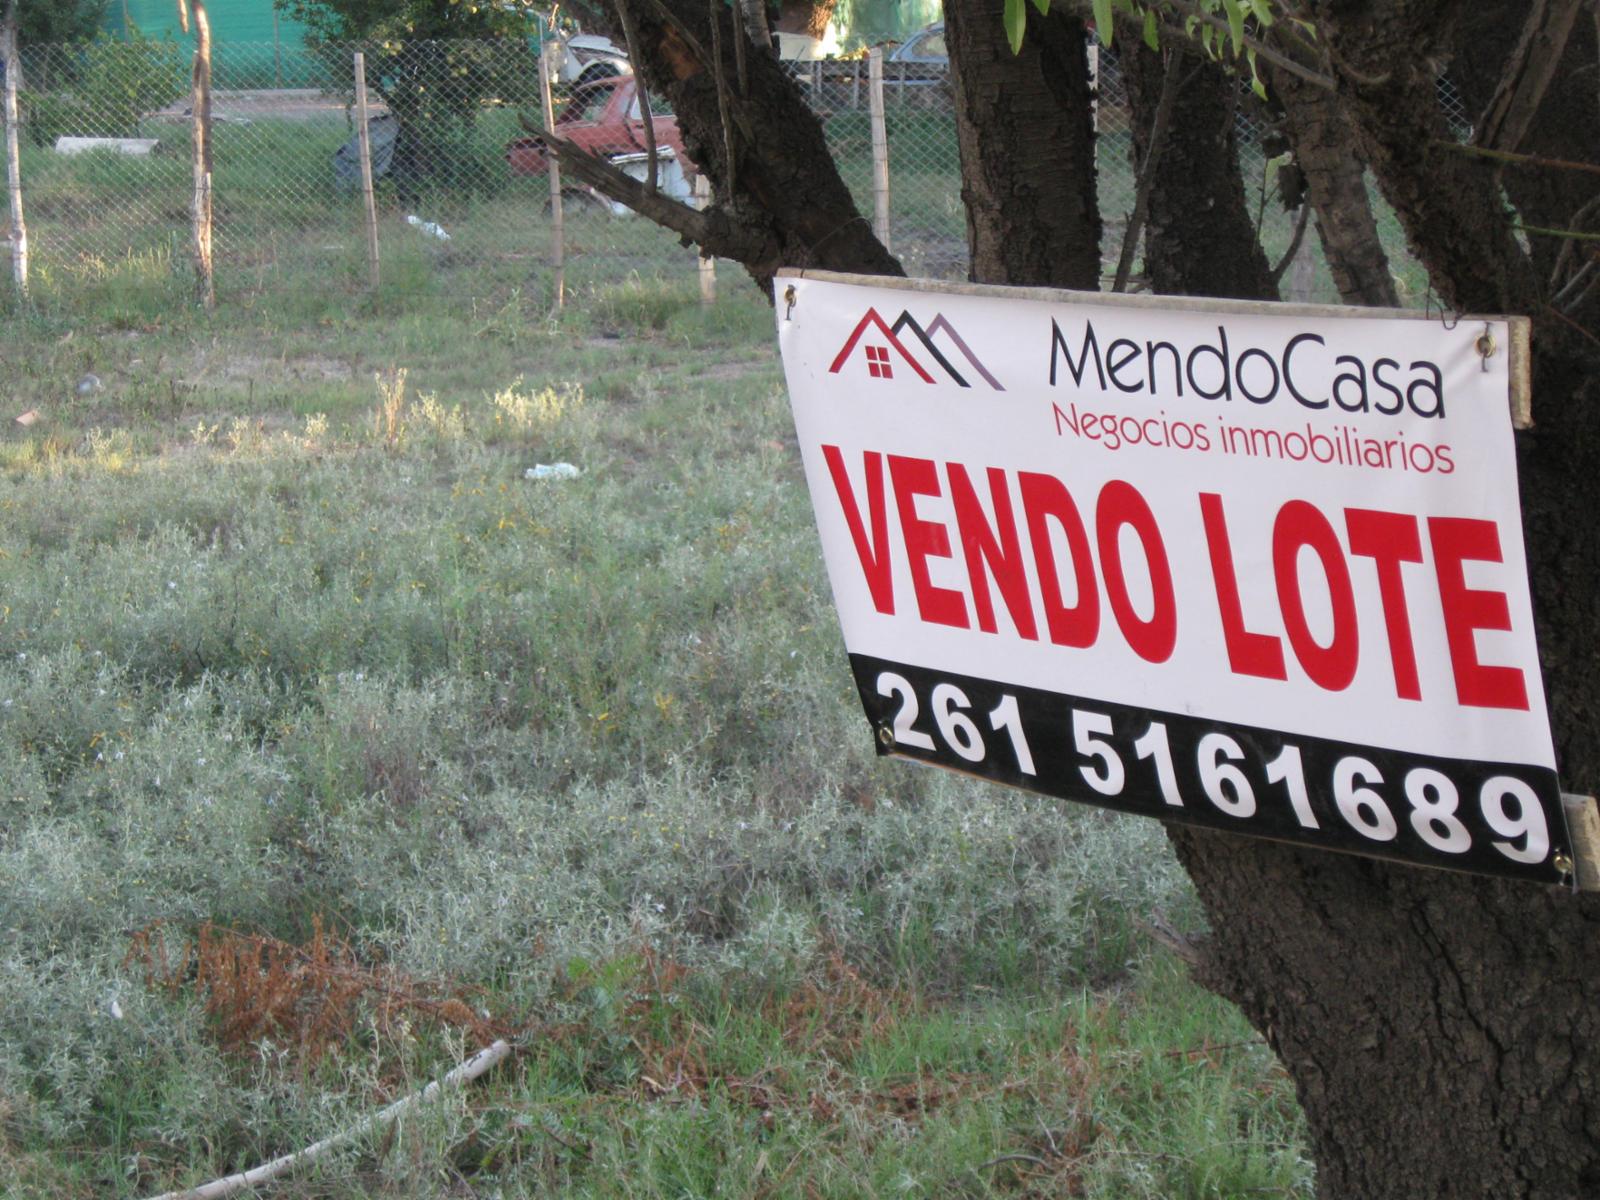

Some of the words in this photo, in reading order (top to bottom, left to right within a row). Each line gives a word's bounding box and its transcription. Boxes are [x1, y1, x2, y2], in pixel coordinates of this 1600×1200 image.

[1049, 316, 1446, 419] MendoCasa
[1052, 402, 1211, 451] Negocios
[1220, 416, 1455, 474] inmobiliarios
[821, 444, 1178, 664] VENDO
[1198, 492, 1530, 711] LOTE
[875, 670, 1038, 776] 261
[1071, 708, 1551, 864] 5161689
